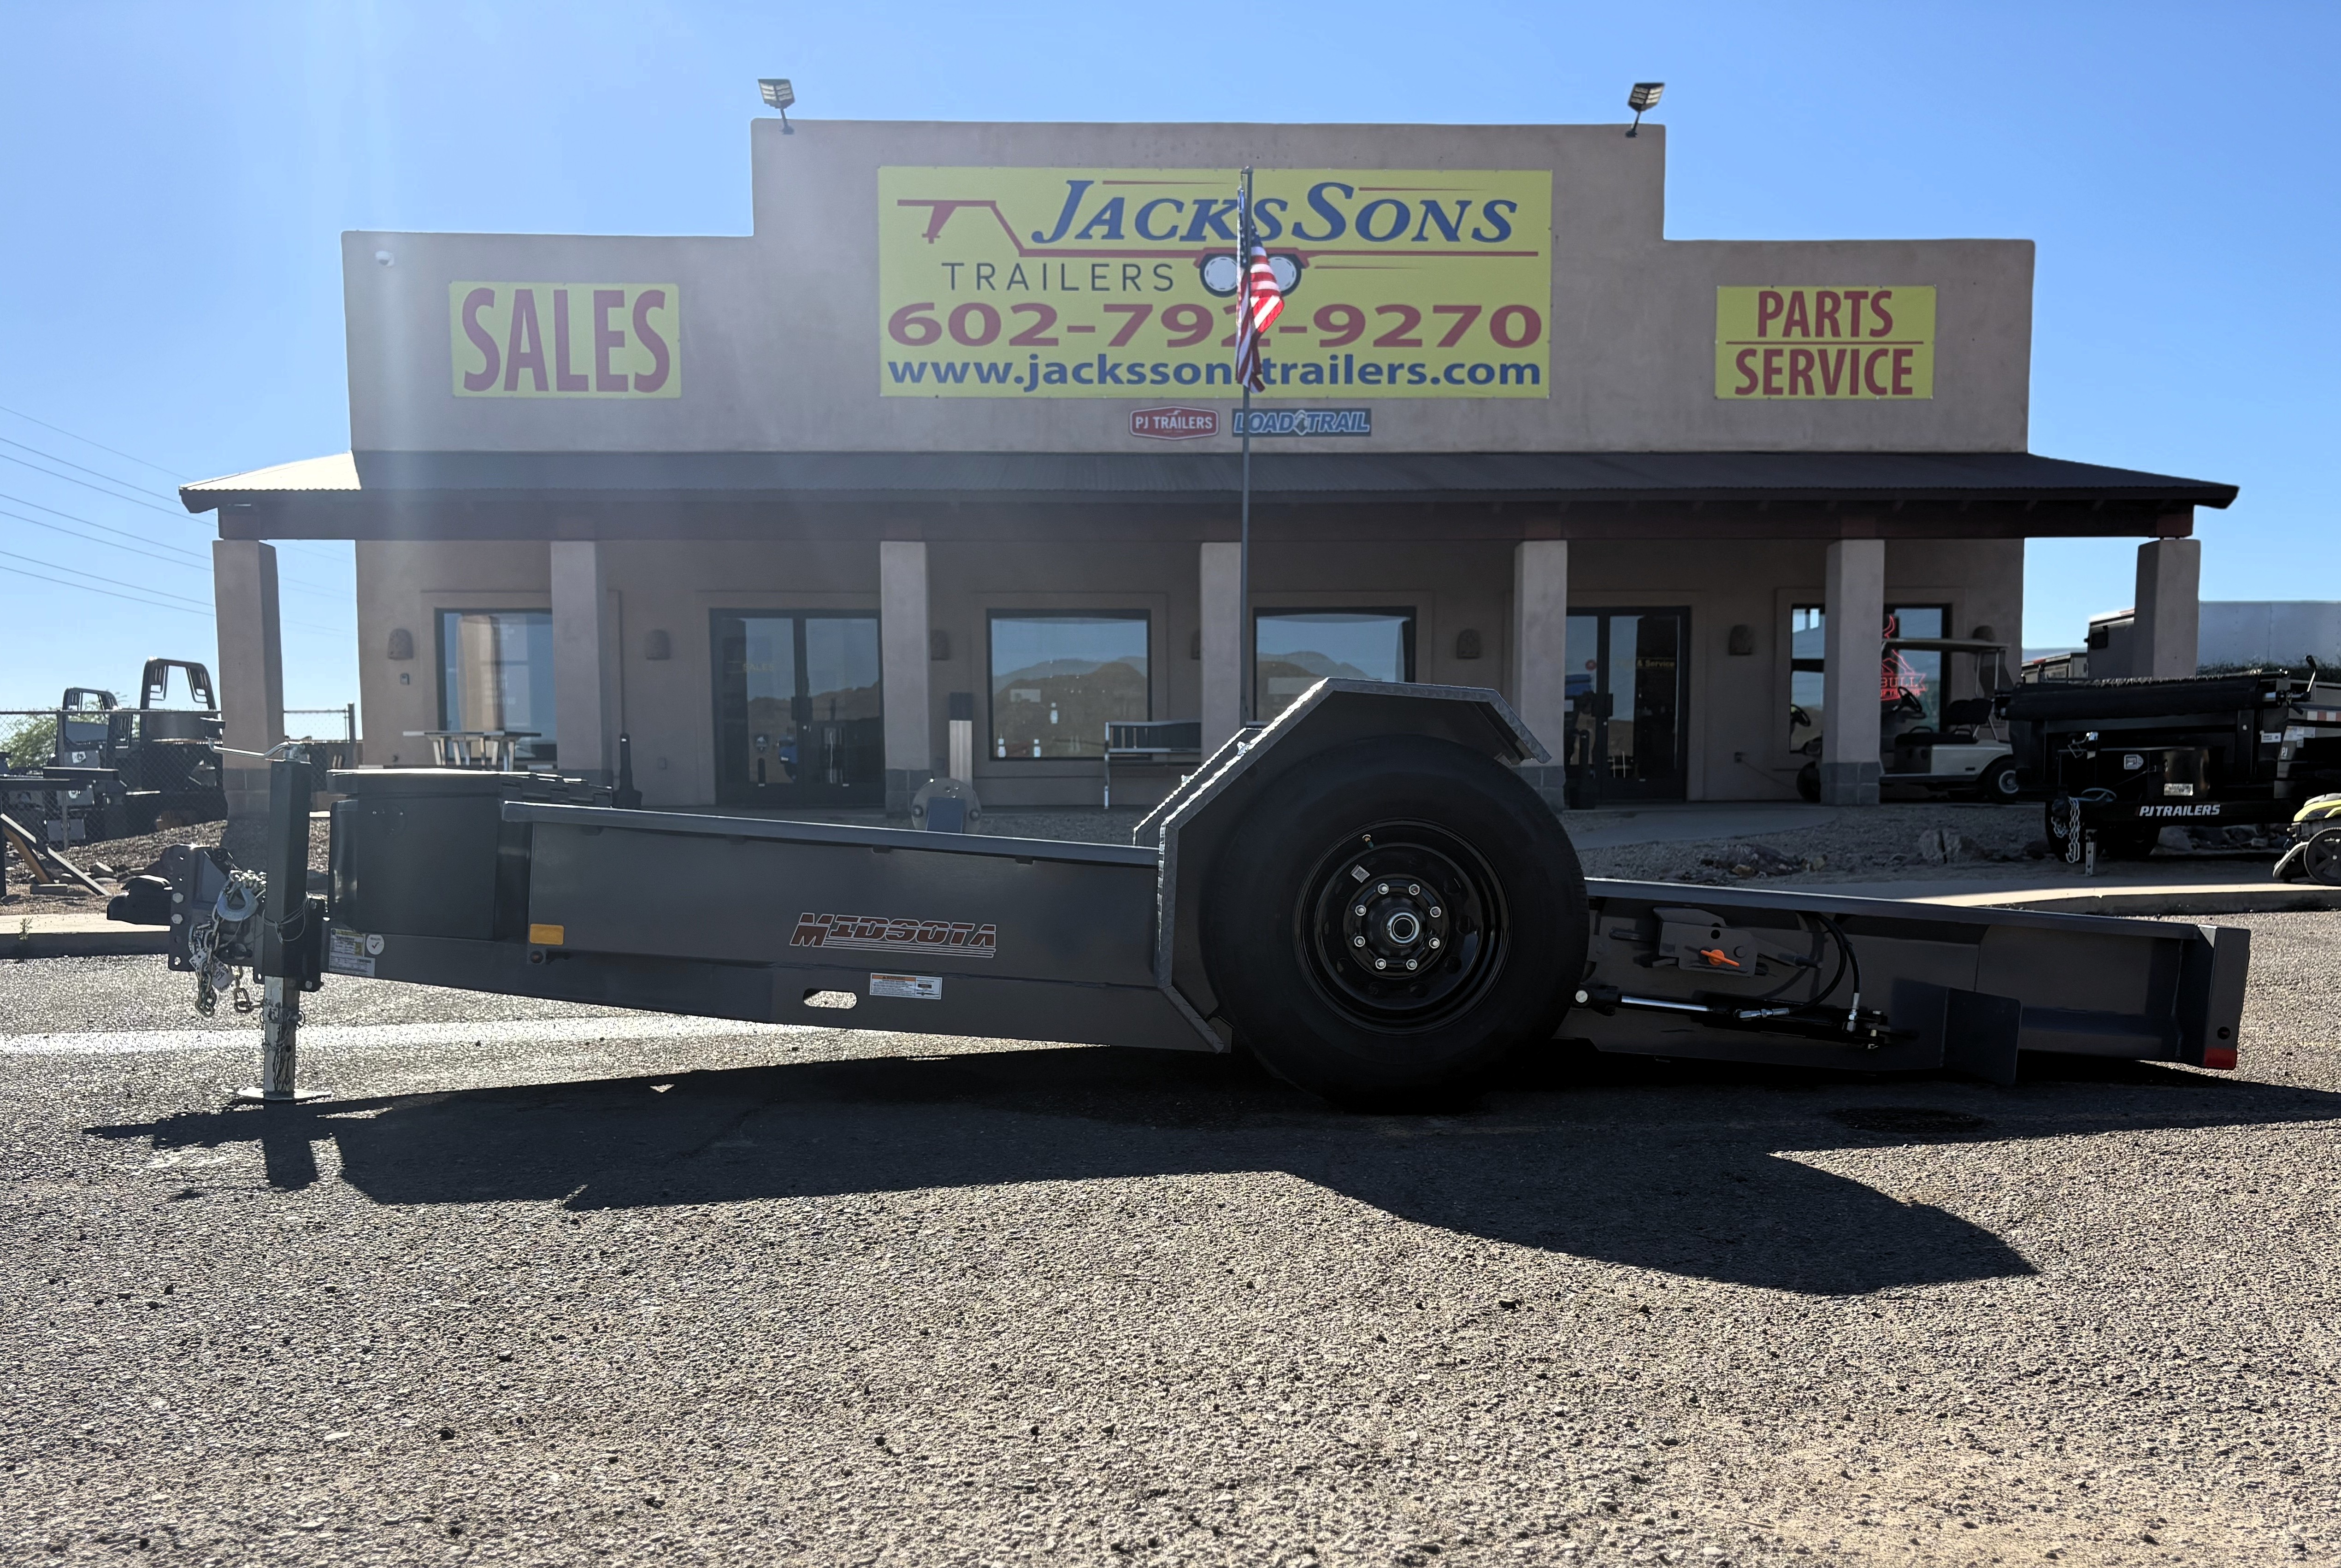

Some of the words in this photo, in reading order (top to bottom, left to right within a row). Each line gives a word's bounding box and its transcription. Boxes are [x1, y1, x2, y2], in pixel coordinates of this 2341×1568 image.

[941, 262, 1174, 292] TRAILERS
[1757, 290, 1893, 337] PARTS
[462, 288, 670, 393] SALES
[888, 354, 1540, 393] www.jackssontrailers.com
[1734, 348, 1913, 395] SERVICE
[1135, 416, 1149, 429] PJ
[1153, 416, 1213, 429] TRAILERS
[1233, 412, 1294, 433] LOAD
[1305, 412, 1370, 433] TRAIL
[790, 913, 996, 948] MIDSOTA
